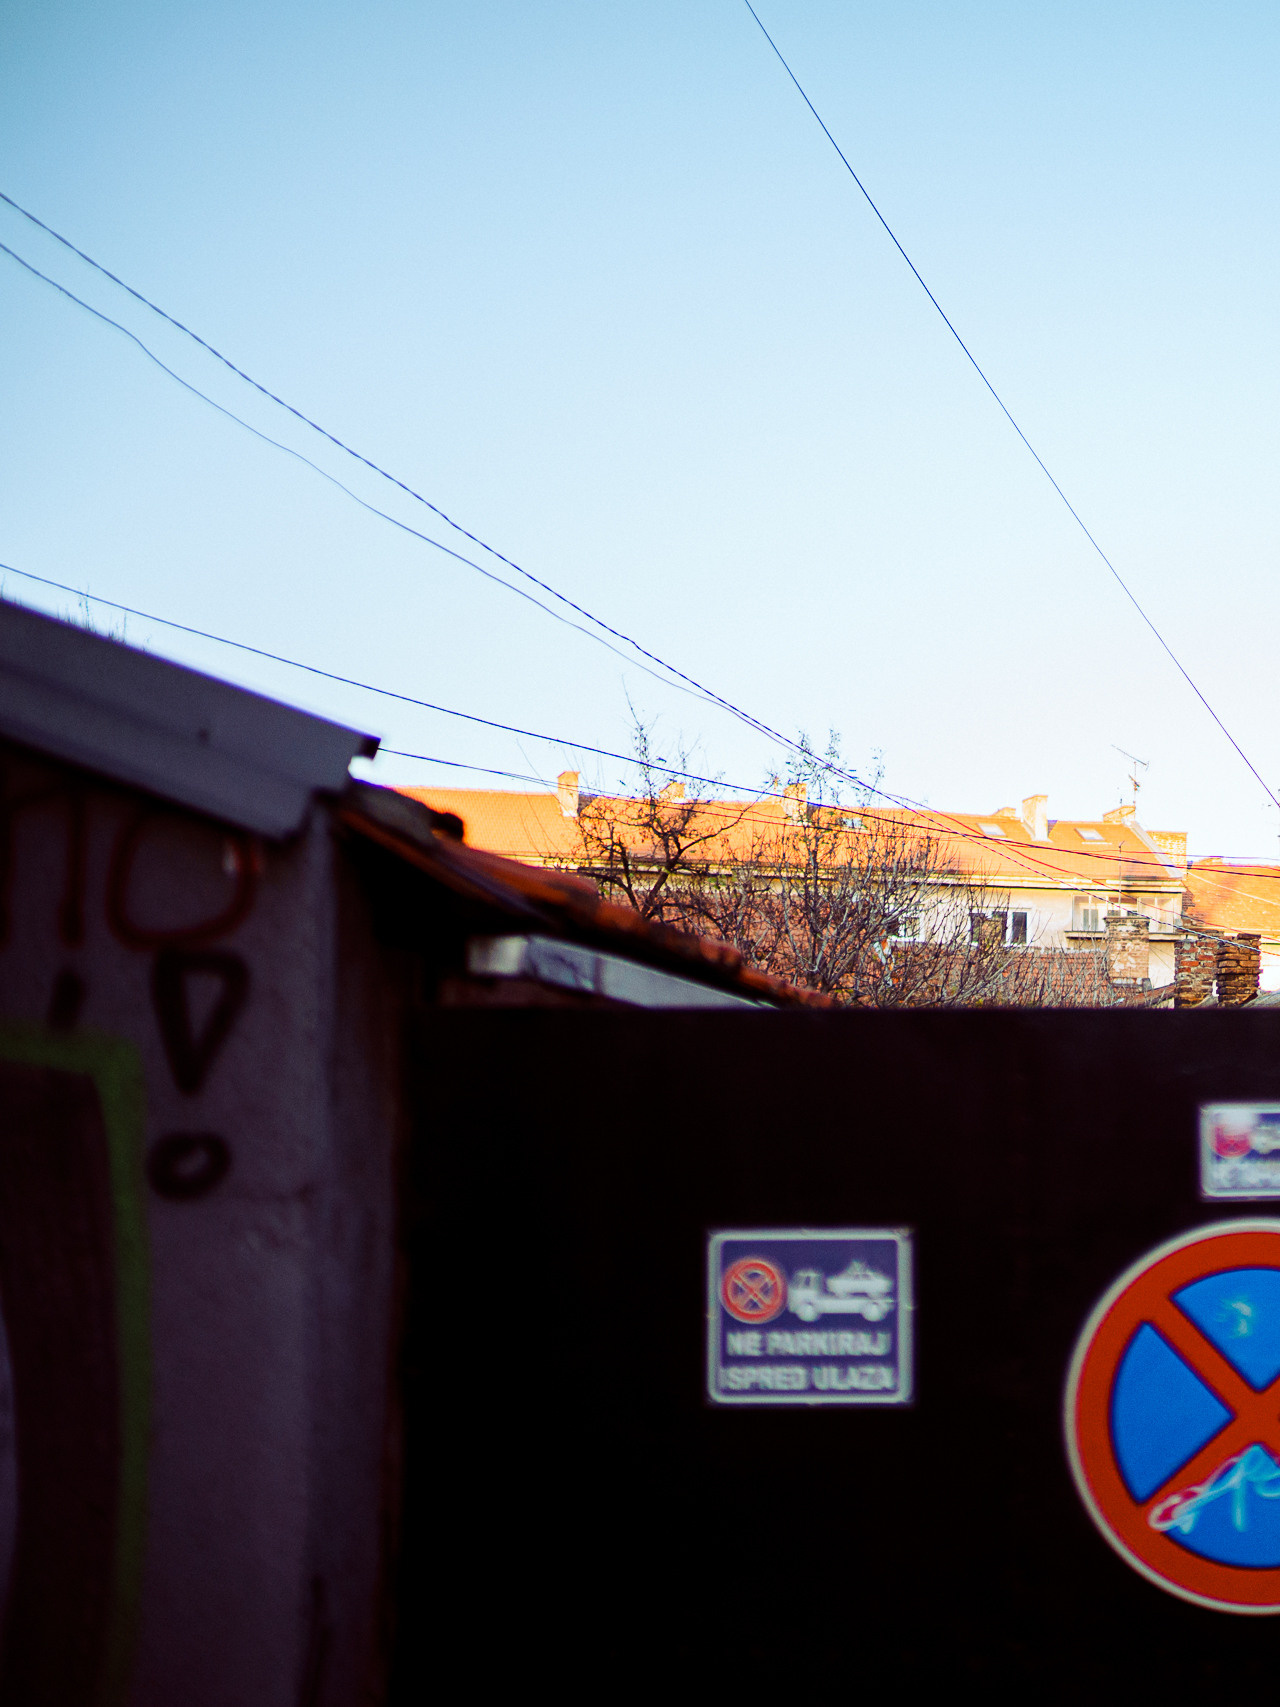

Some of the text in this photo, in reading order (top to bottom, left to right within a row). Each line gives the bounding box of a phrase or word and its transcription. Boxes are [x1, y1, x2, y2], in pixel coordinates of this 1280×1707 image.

[727, 1332, 891, 1356] NE PARKIRAJ
[720, 1366, 895, 1390] ISPRED ULAZA
